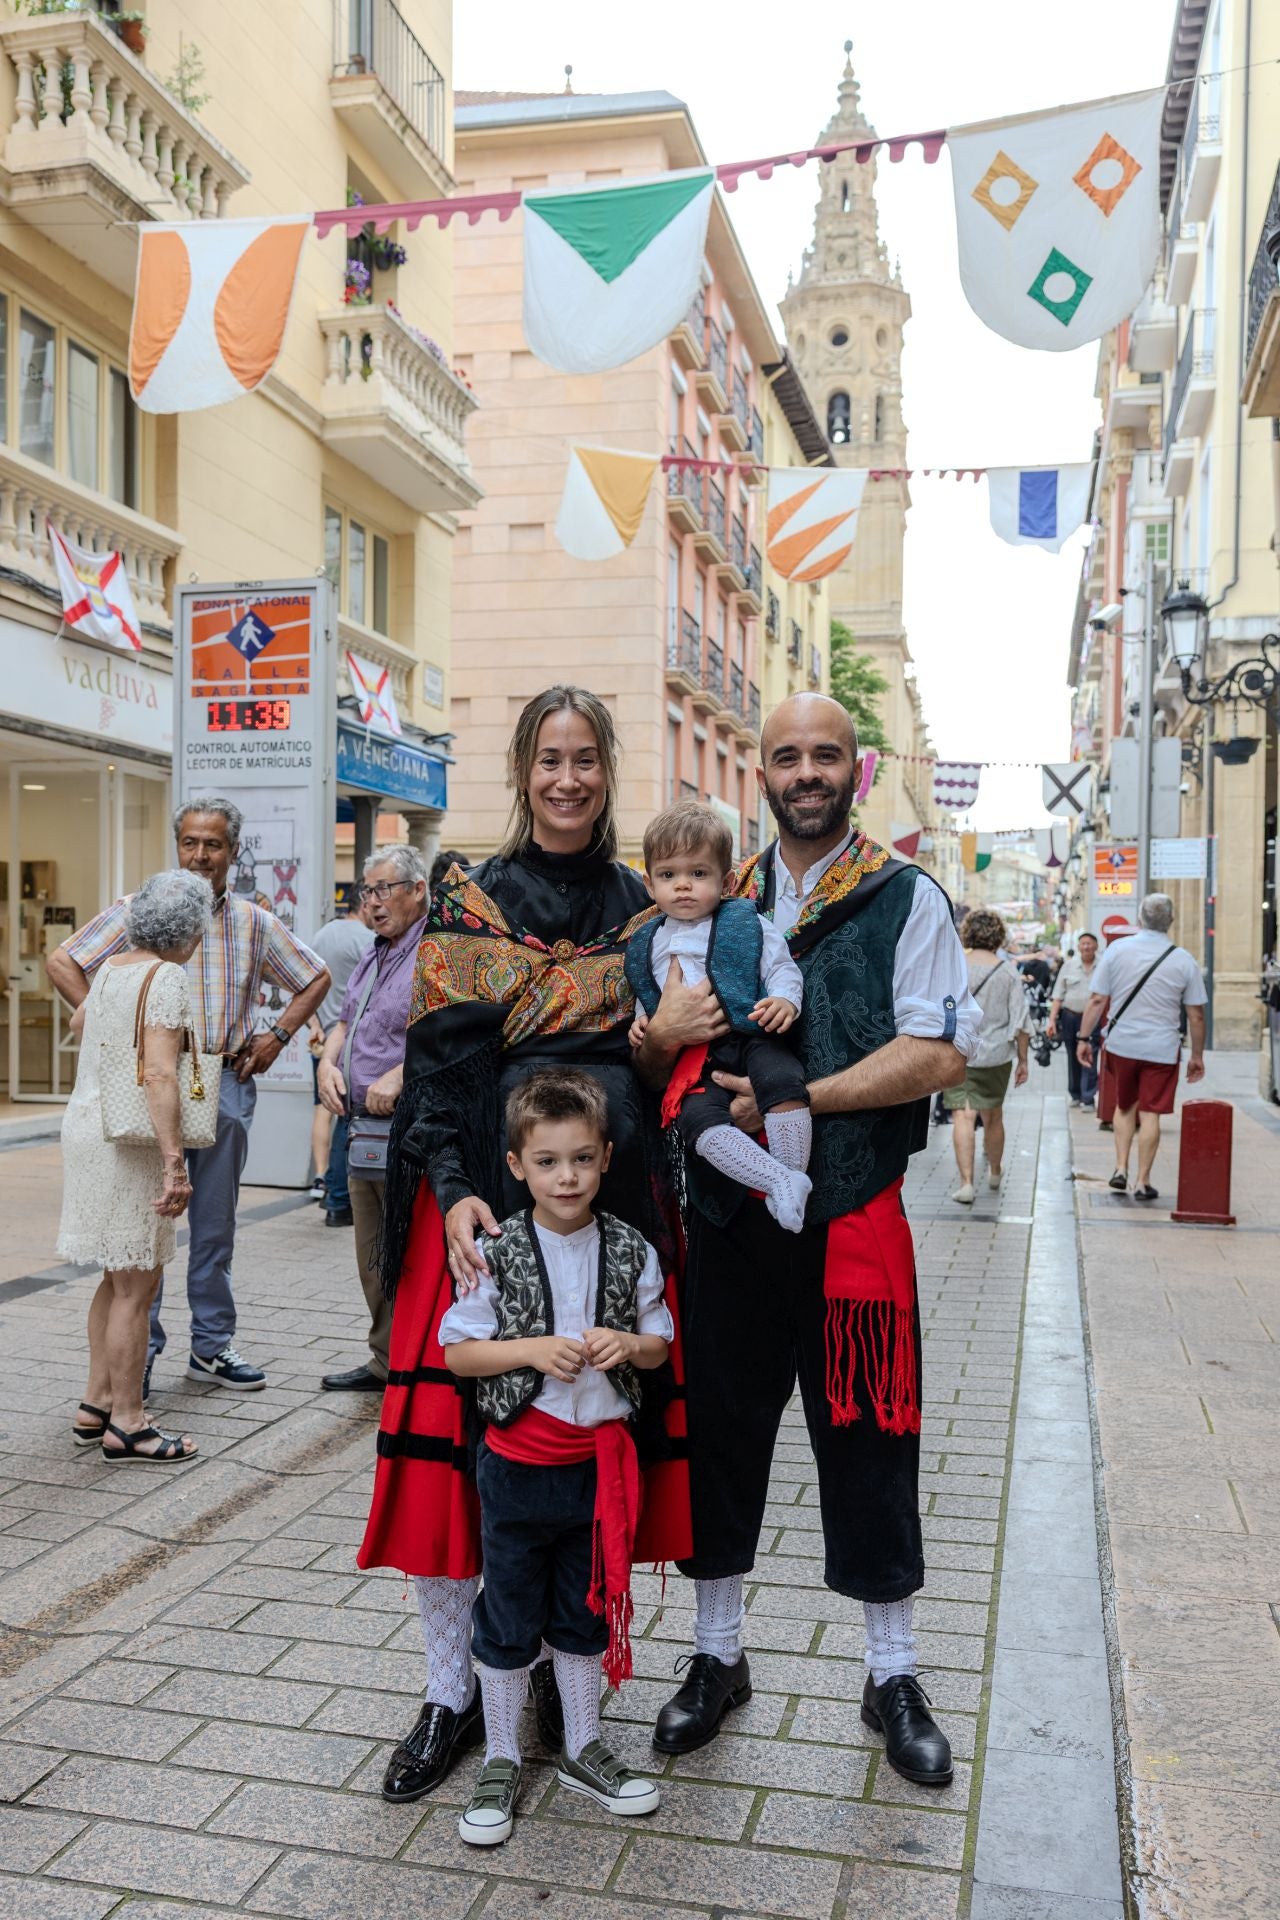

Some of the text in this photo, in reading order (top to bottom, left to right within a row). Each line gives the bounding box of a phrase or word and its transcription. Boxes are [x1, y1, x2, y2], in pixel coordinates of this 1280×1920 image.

[193, 600, 231, 611] ZONA
[198, 666, 305, 679] CALLE
[62, 656, 158, 710] vaduva
[195, 683, 306, 697] SAGASTA
[208, 701, 290, 731] 11:39
[186, 738, 312, 754] CONTROL AUTOMÁTICO
[187, 754, 312, 770] LECTOR DE MATRÍCULAS
[352, 737, 430, 783] VENECIANA
